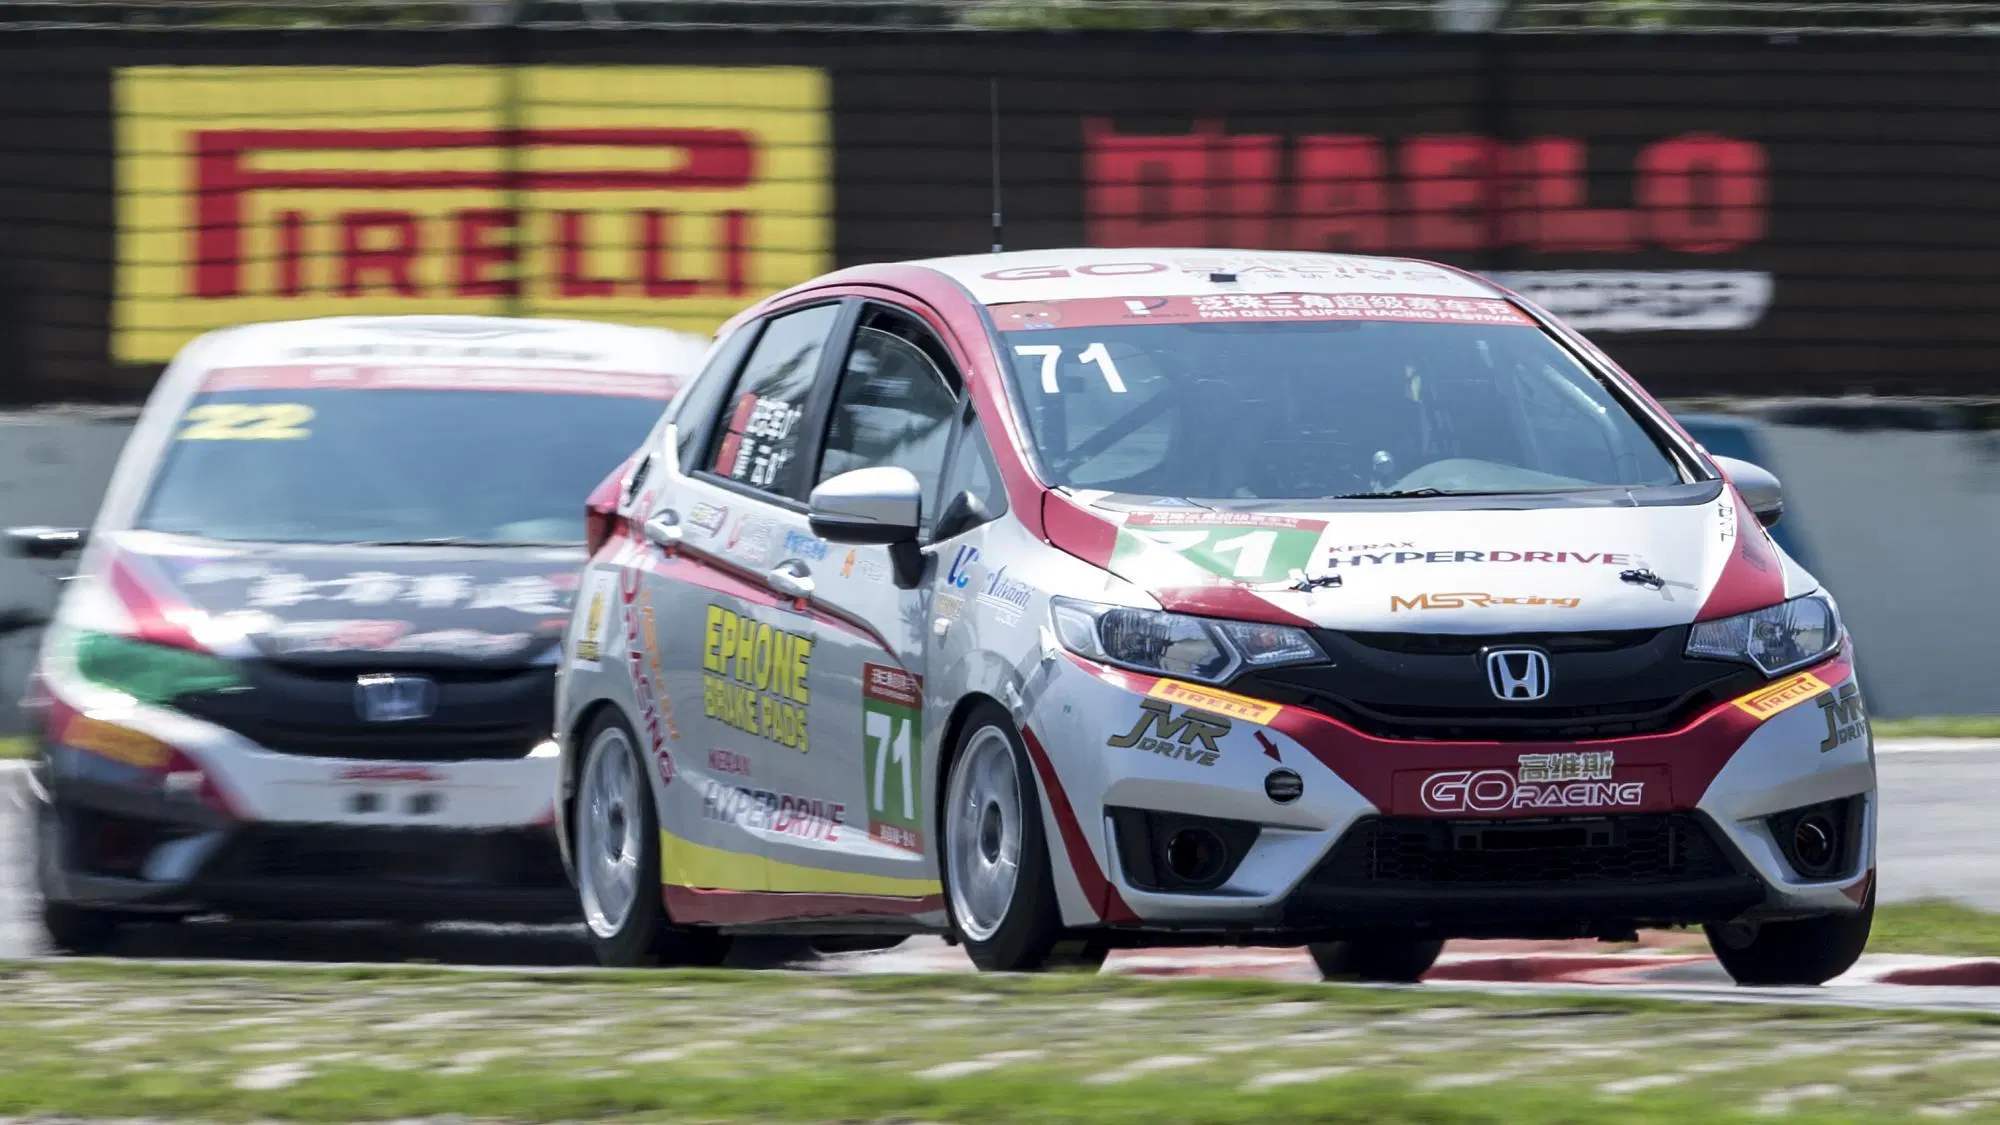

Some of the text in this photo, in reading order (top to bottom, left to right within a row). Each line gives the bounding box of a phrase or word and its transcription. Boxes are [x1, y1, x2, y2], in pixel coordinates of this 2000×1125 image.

[187, 128, 757, 298] PIRELLI
[1240, 309, 1299, 317] DELTA
[1302, 308, 1362, 317] SUPER
[1365, 309, 1439, 319] RACING
[1440, 311, 1524, 321] FESTIVAL
[1014, 342, 1127, 393] 71
[178, 403, 315, 440] 22
[1328, 541, 1415, 553] KERAX
[1328, 550, 1630, 568] HYPERDRIVE
[703, 604, 813, 705] EPHONE
[1162, 682, 1267, 718] PIRELLI
[1745, 675, 1817, 713] PIRELLI
[761, 695, 810, 755] PADS
[866, 711, 915, 819] 71
[1127, 737, 1220, 767] DRIVE
[1518, 751, 1614, 783] 高维斯
[1512, 782, 1645, 809] RACING
